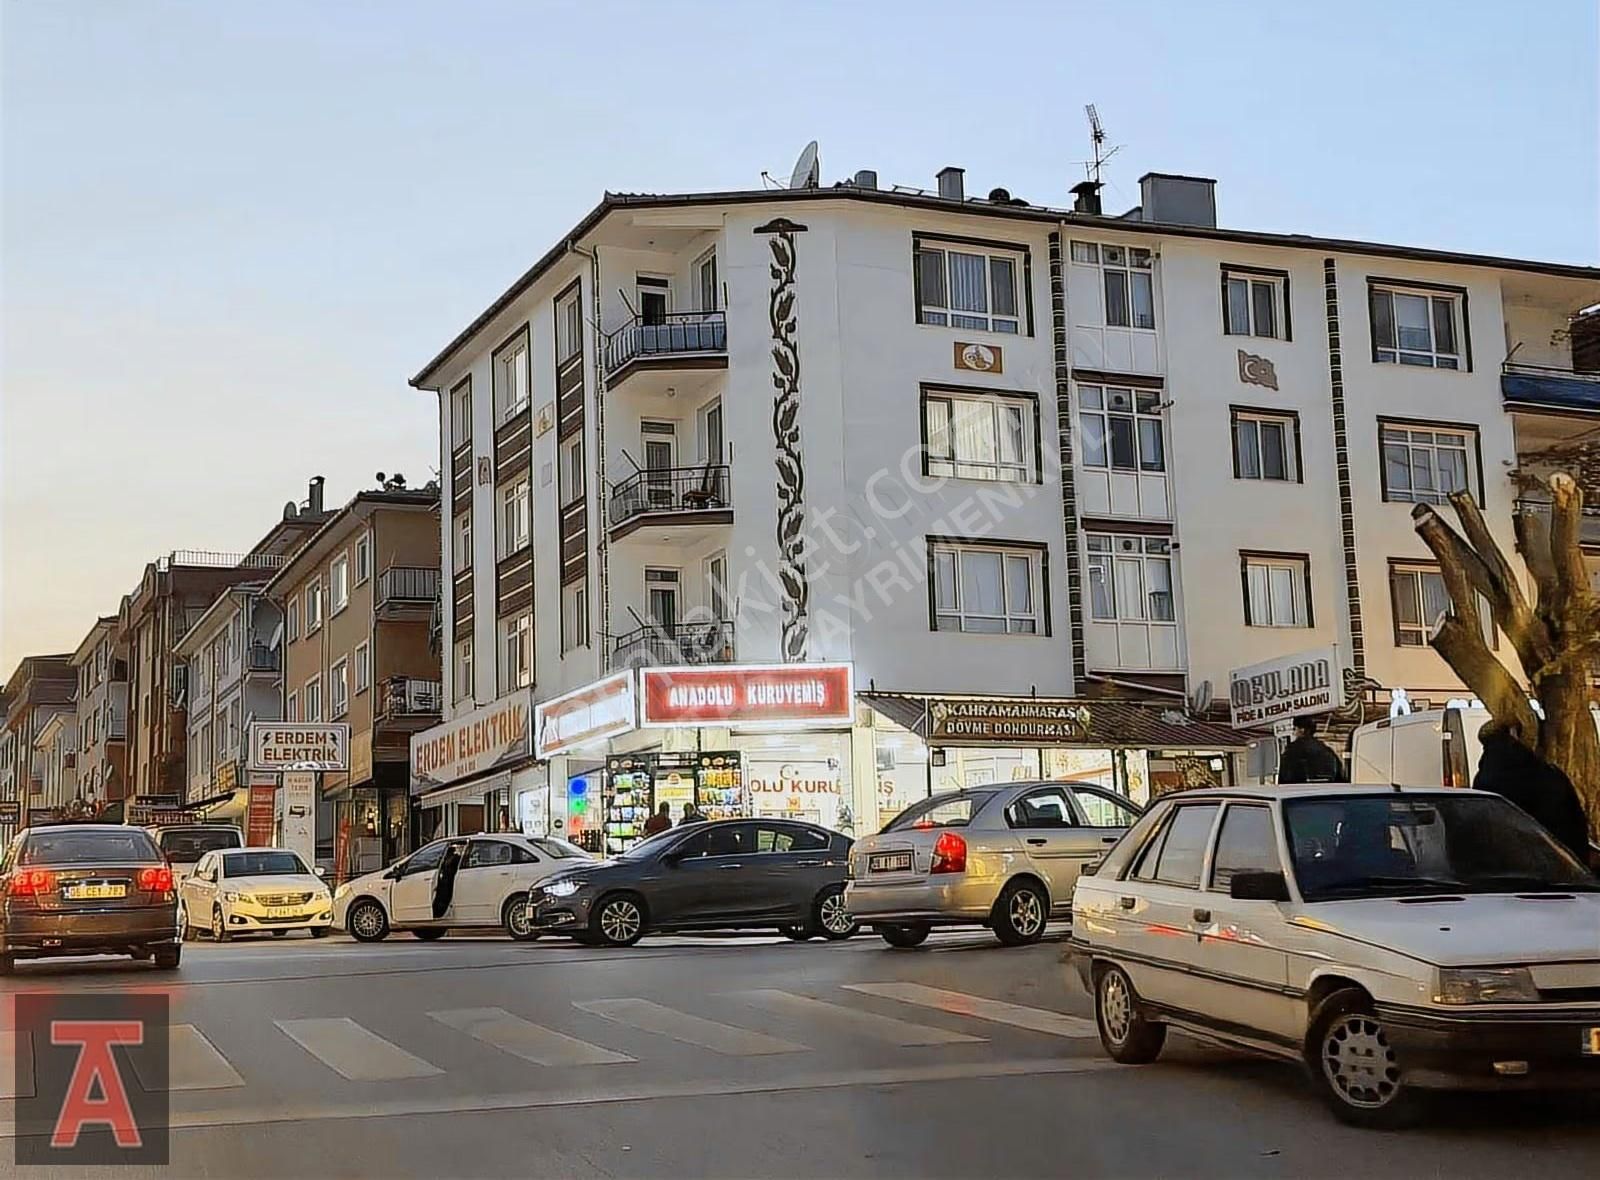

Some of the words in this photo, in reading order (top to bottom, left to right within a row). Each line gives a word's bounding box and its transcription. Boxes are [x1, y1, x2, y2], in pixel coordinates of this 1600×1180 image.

[669, 684, 734, 708] ANADOLU
[747, 680, 825, 707] KURUYEMİŞ
[275, 732, 327, 744] ERDEM
[416, 730, 455, 776] ERDEM
[459, 700, 524, 759] ELEKTRİK
[264, 745, 337, 761] ELEKTRİK
